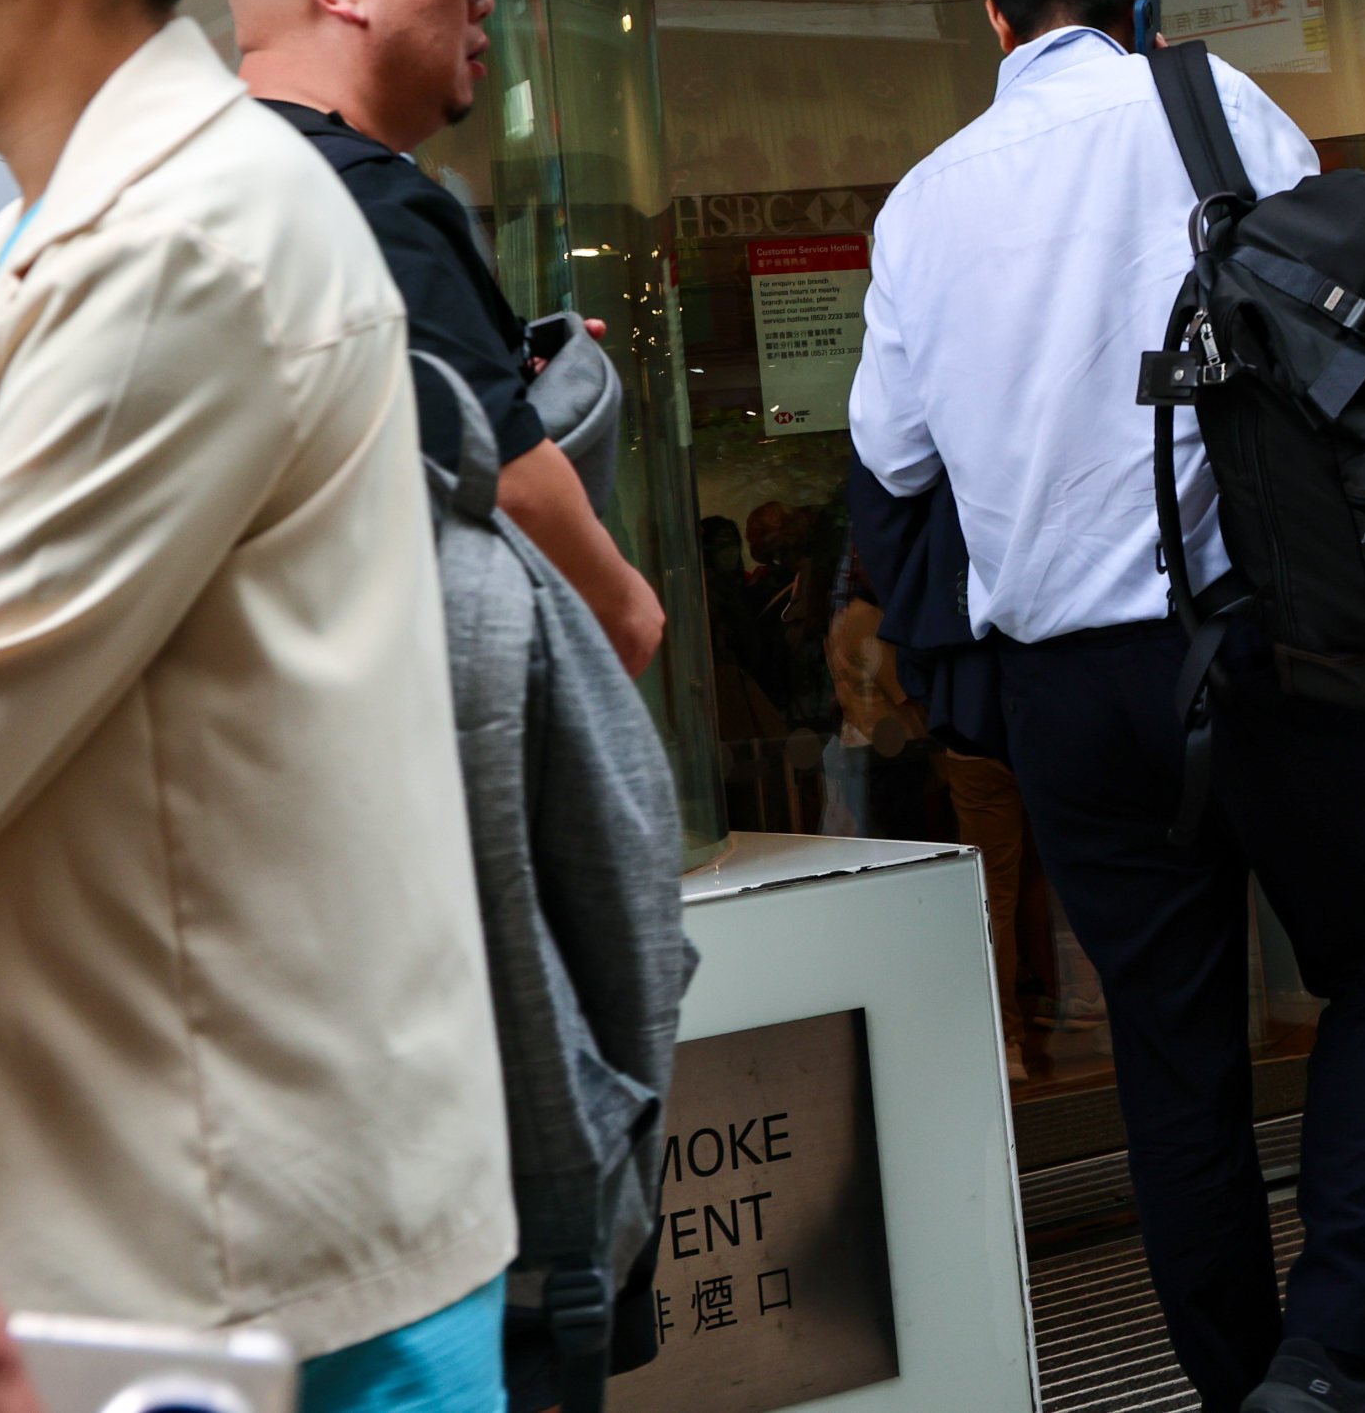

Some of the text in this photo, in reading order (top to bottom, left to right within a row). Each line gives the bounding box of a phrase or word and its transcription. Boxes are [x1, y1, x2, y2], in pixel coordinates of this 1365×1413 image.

[672, 193, 794, 238] HSBC
[756, 243, 860, 257] Customer Service Hotline
